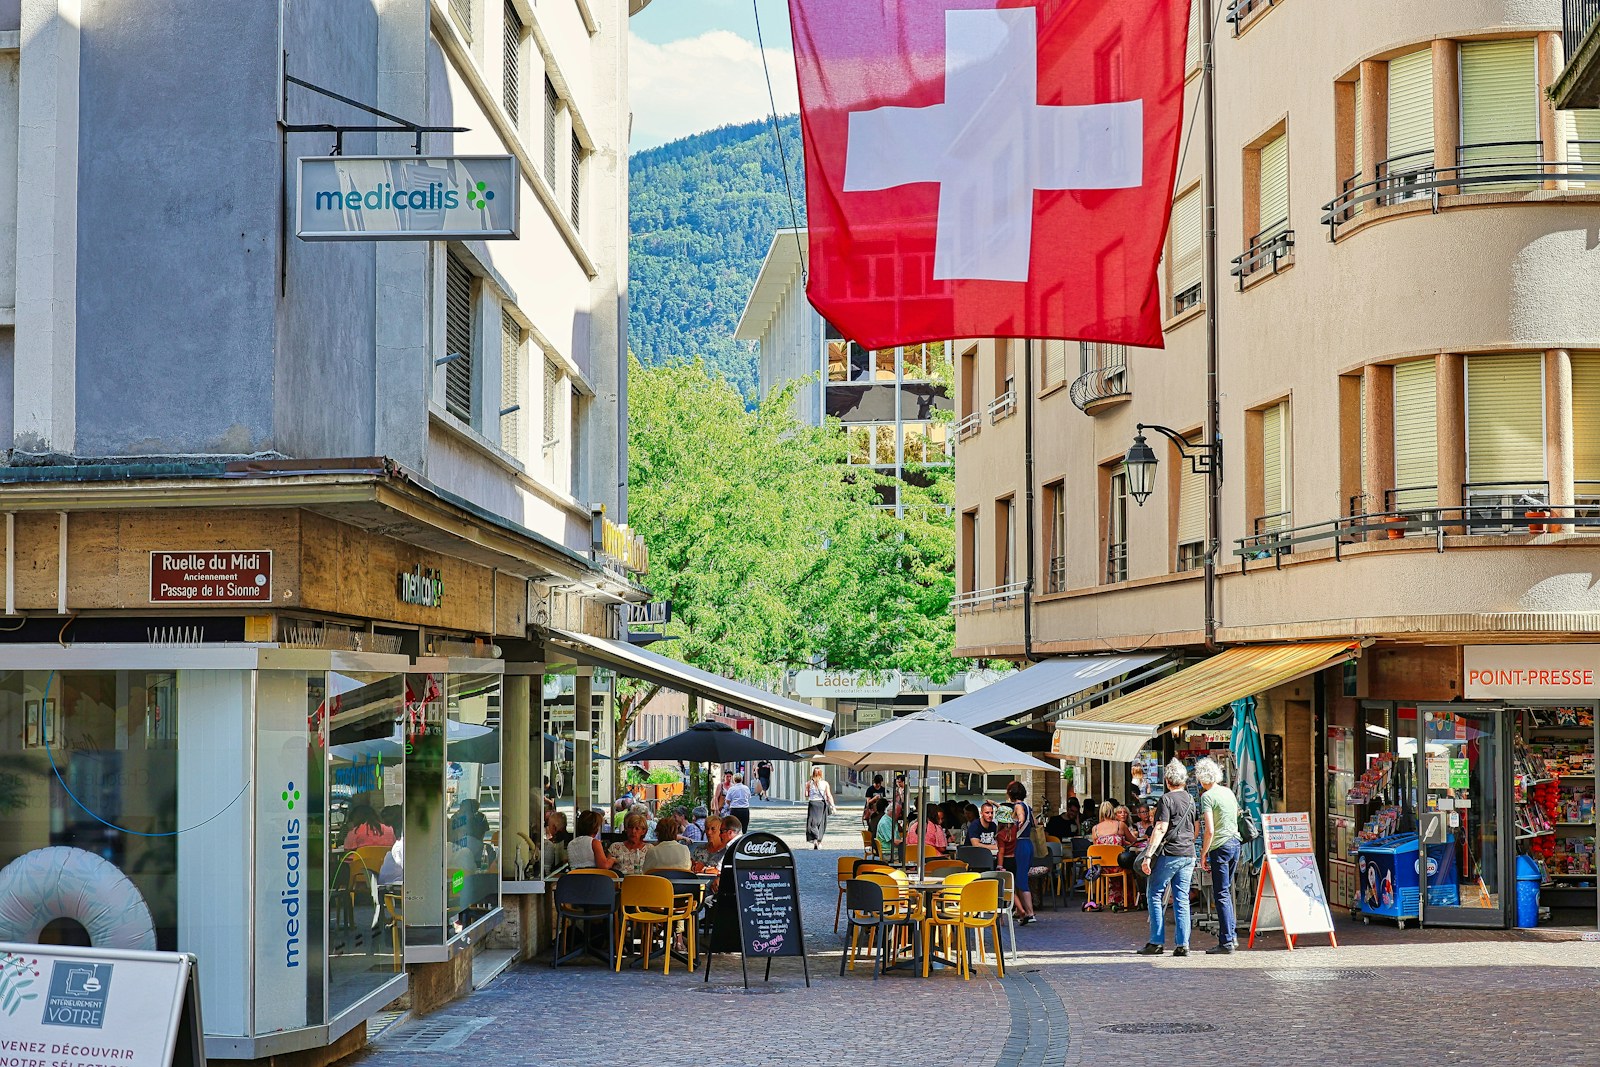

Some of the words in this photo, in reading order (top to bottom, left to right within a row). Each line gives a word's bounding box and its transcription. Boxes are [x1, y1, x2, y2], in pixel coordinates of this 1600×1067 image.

[316, 182, 459, 211] medicalis
[162, 554, 205, 571] Ruelle
[209, 554, 226, 570] du
[231, 553, 260, 570] Midi
[184, 572, 238, 581] Anciennement
[160, 583, 198, 599] Passage
[201, 584, 213, 596] de
[215, 584, 224, 596] la
[227, 582, 260, 597] Sionne
[816, 675, 881, 688] Läderch
[1468, 669, 1593, 686] POINT-PRESSE
[335, 752, 375, 798] medicalis
[744, 841, 778, 854] Coca-Cola
[281, 818, 300, 969] medicalis
[48, 1006, 101, 1025] VÔTRE
[1, 1040, 47, 1053] VENEZ
[51, 1042, 135, 1060] DÉCOUVRIR
[0, 1057, 46, 1067] NOTRE
